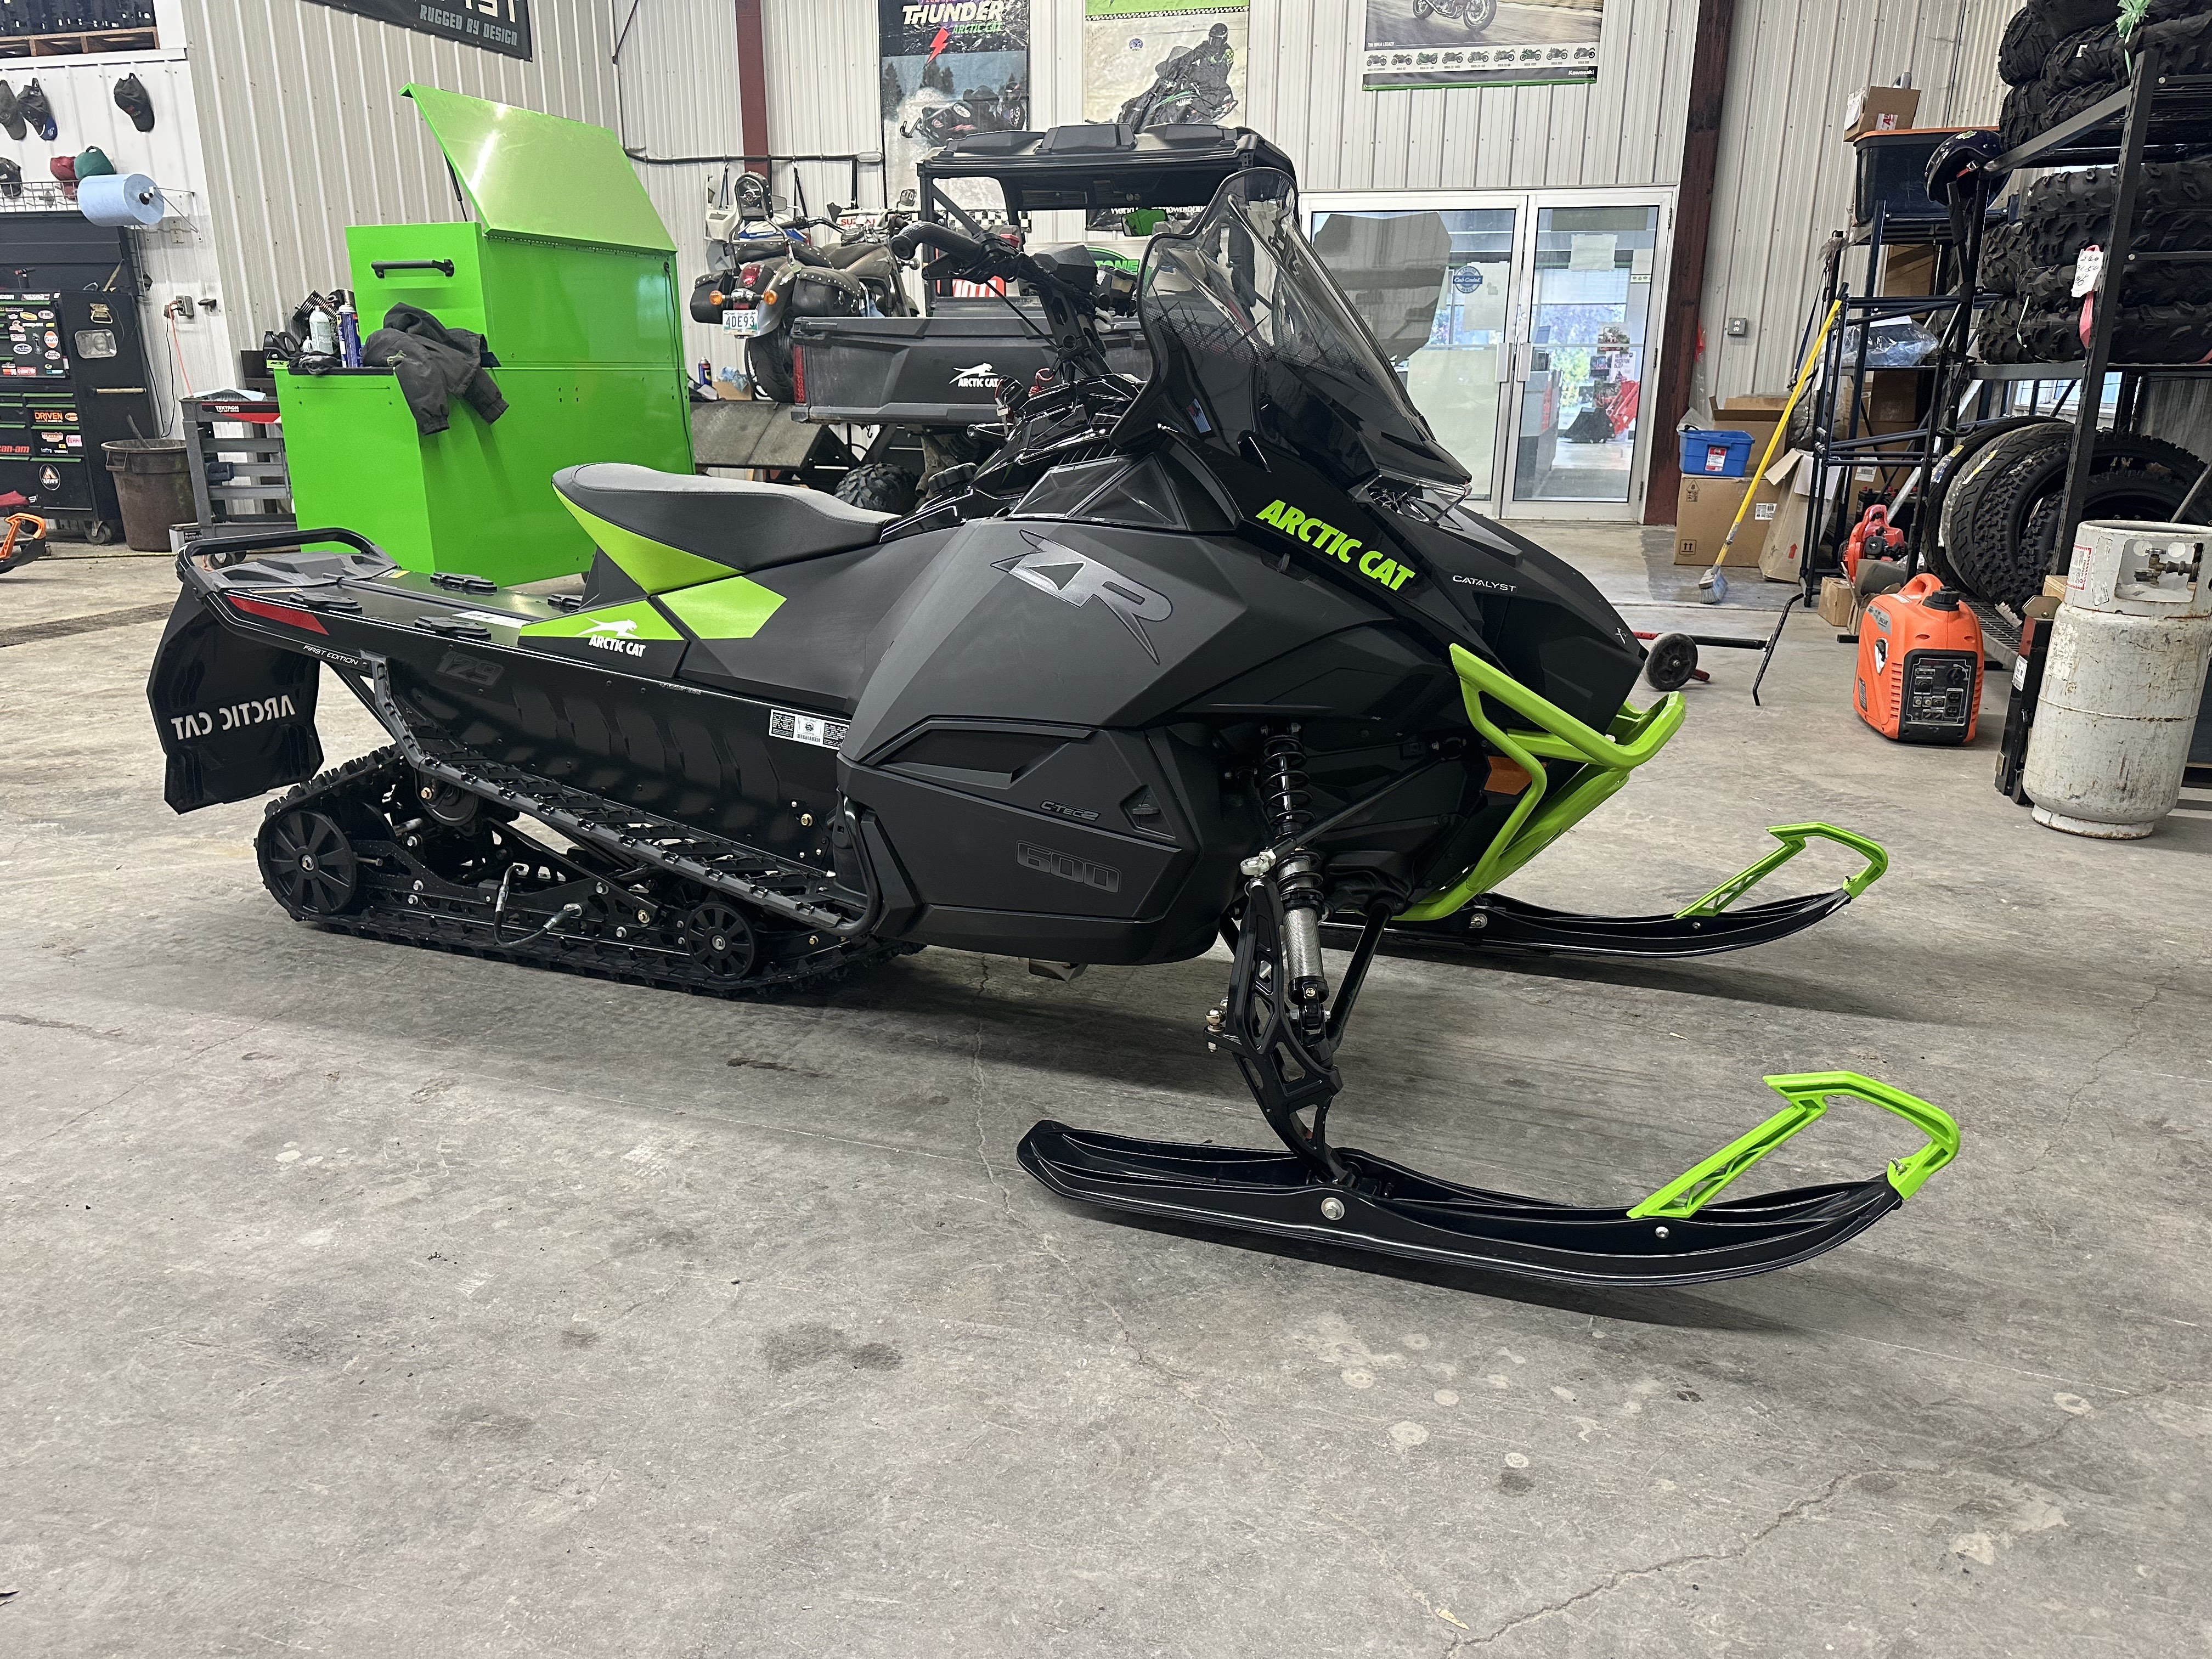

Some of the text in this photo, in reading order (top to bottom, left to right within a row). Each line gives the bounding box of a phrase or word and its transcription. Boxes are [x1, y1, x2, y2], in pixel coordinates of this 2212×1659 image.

[902, 1, 1003, 25] THUNDER
[420, 4, 462, 30] RUGGED
[466, 18, 479, 35] BY
[483, 23, 517, 46] DESIGN
[726, 316, 755, 328] 4DE93
[957, 378, 999, 387] ARCTIC CAT
[35, 412, 63, 421] DRIVEN
[1255, 499, 1416, 591] ARCTIC CAT
[1453, 575, 1517, 592] CATALYST
[990, 529, 1173, 665] ZR
[303, 645, 359, 665] FIRST EDITION
[588, 634, 646, 657] ARCTIC CAT
[436, 651, 505, 688] 129
[1041, 799, 1101, 822] C-TEC2
[1017, 840, 1121, 893] 600
